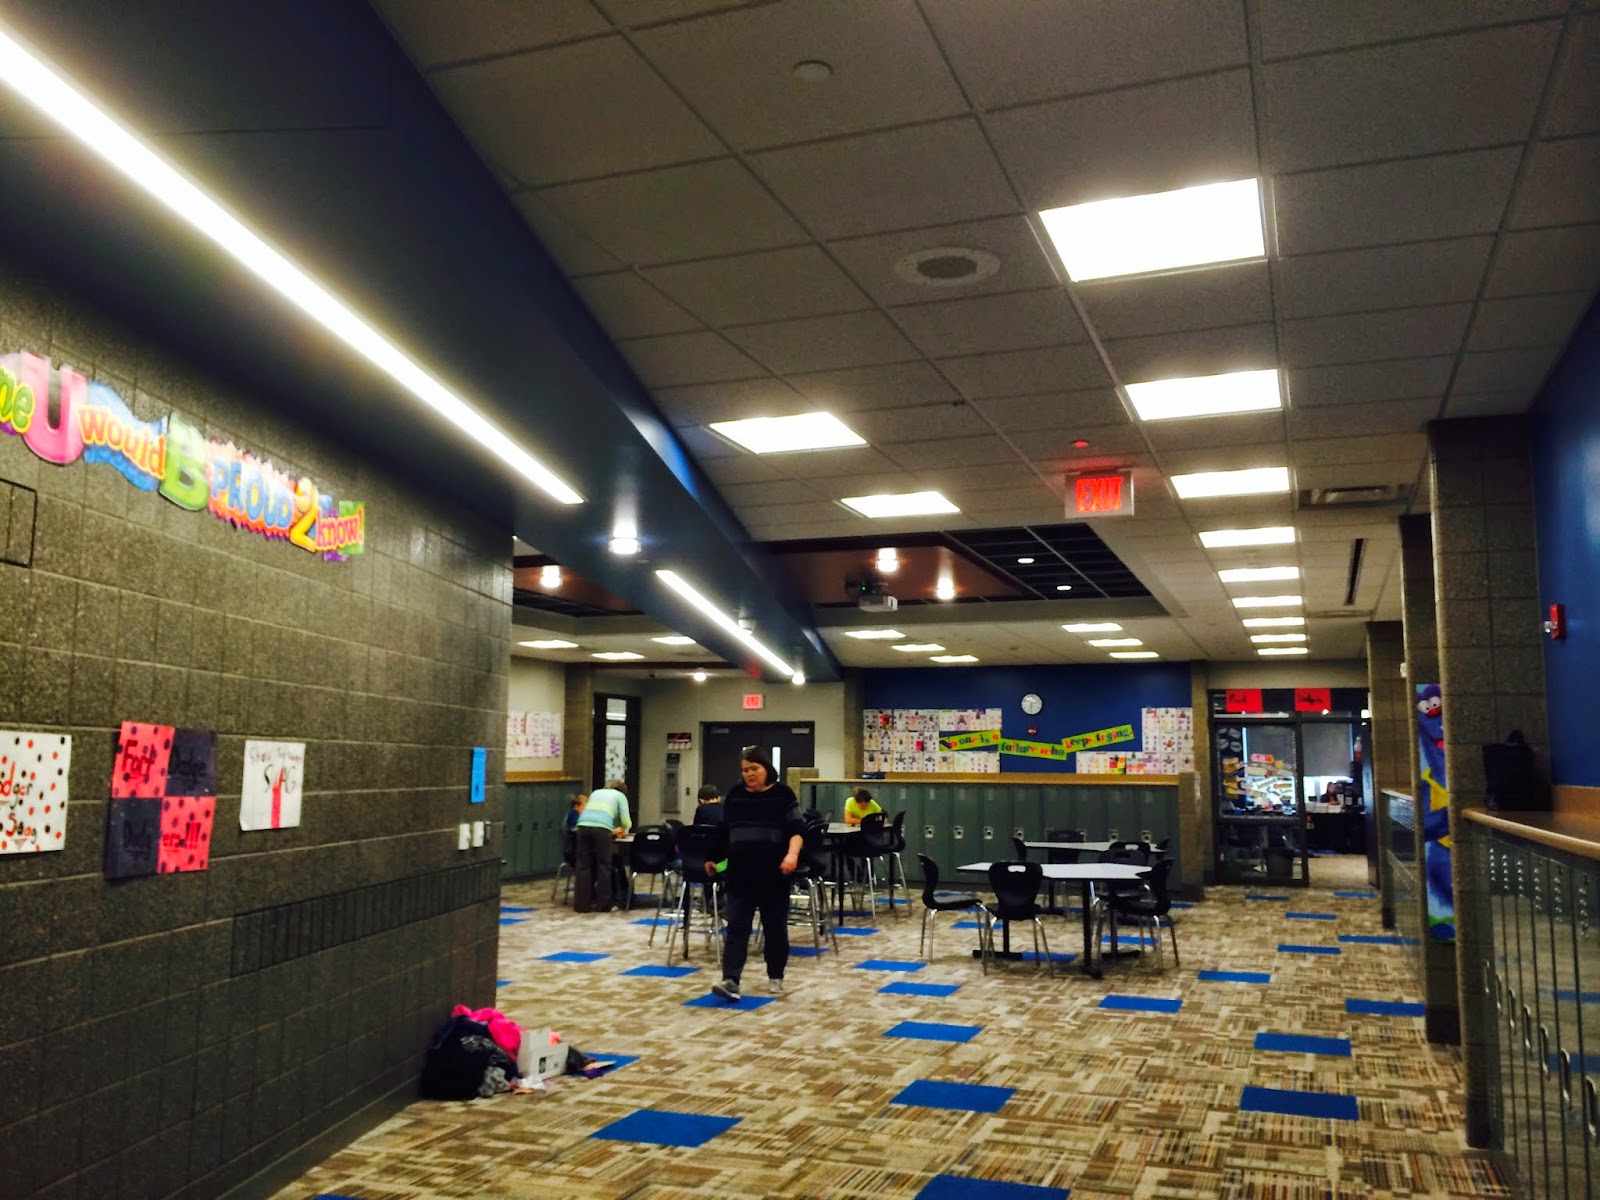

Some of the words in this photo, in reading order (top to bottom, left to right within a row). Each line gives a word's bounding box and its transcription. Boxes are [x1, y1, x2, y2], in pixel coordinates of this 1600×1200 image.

[20, 350, 88, 465] U
[159, 416, 209, 511] B
[211, 457, 295, 530] PROUD
[290, 477, 320, 553] 2
[315, 503, 365, 551] know!
[1075, 475, 1123, 513] EXIT
[0, 761, 33, 810] dger
